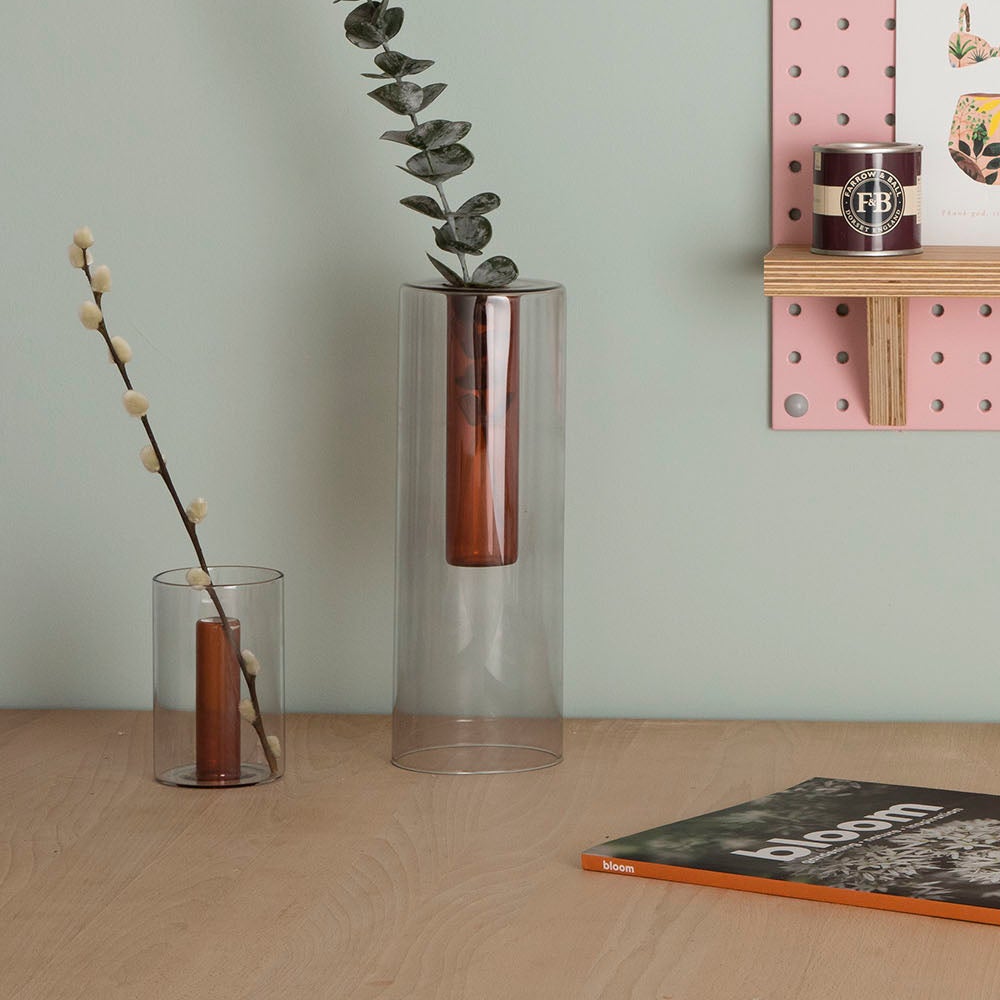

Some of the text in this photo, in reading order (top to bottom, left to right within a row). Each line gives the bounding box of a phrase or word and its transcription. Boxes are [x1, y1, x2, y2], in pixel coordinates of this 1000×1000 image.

[844, 172, 876, 197] FARROW
[887, 174, 902, 197] BALL
[845, 209, 901, 234] DORSET ENGLAND
[730, 803, 944, 862] bloom
[602, 860, 635, 873] bloom
